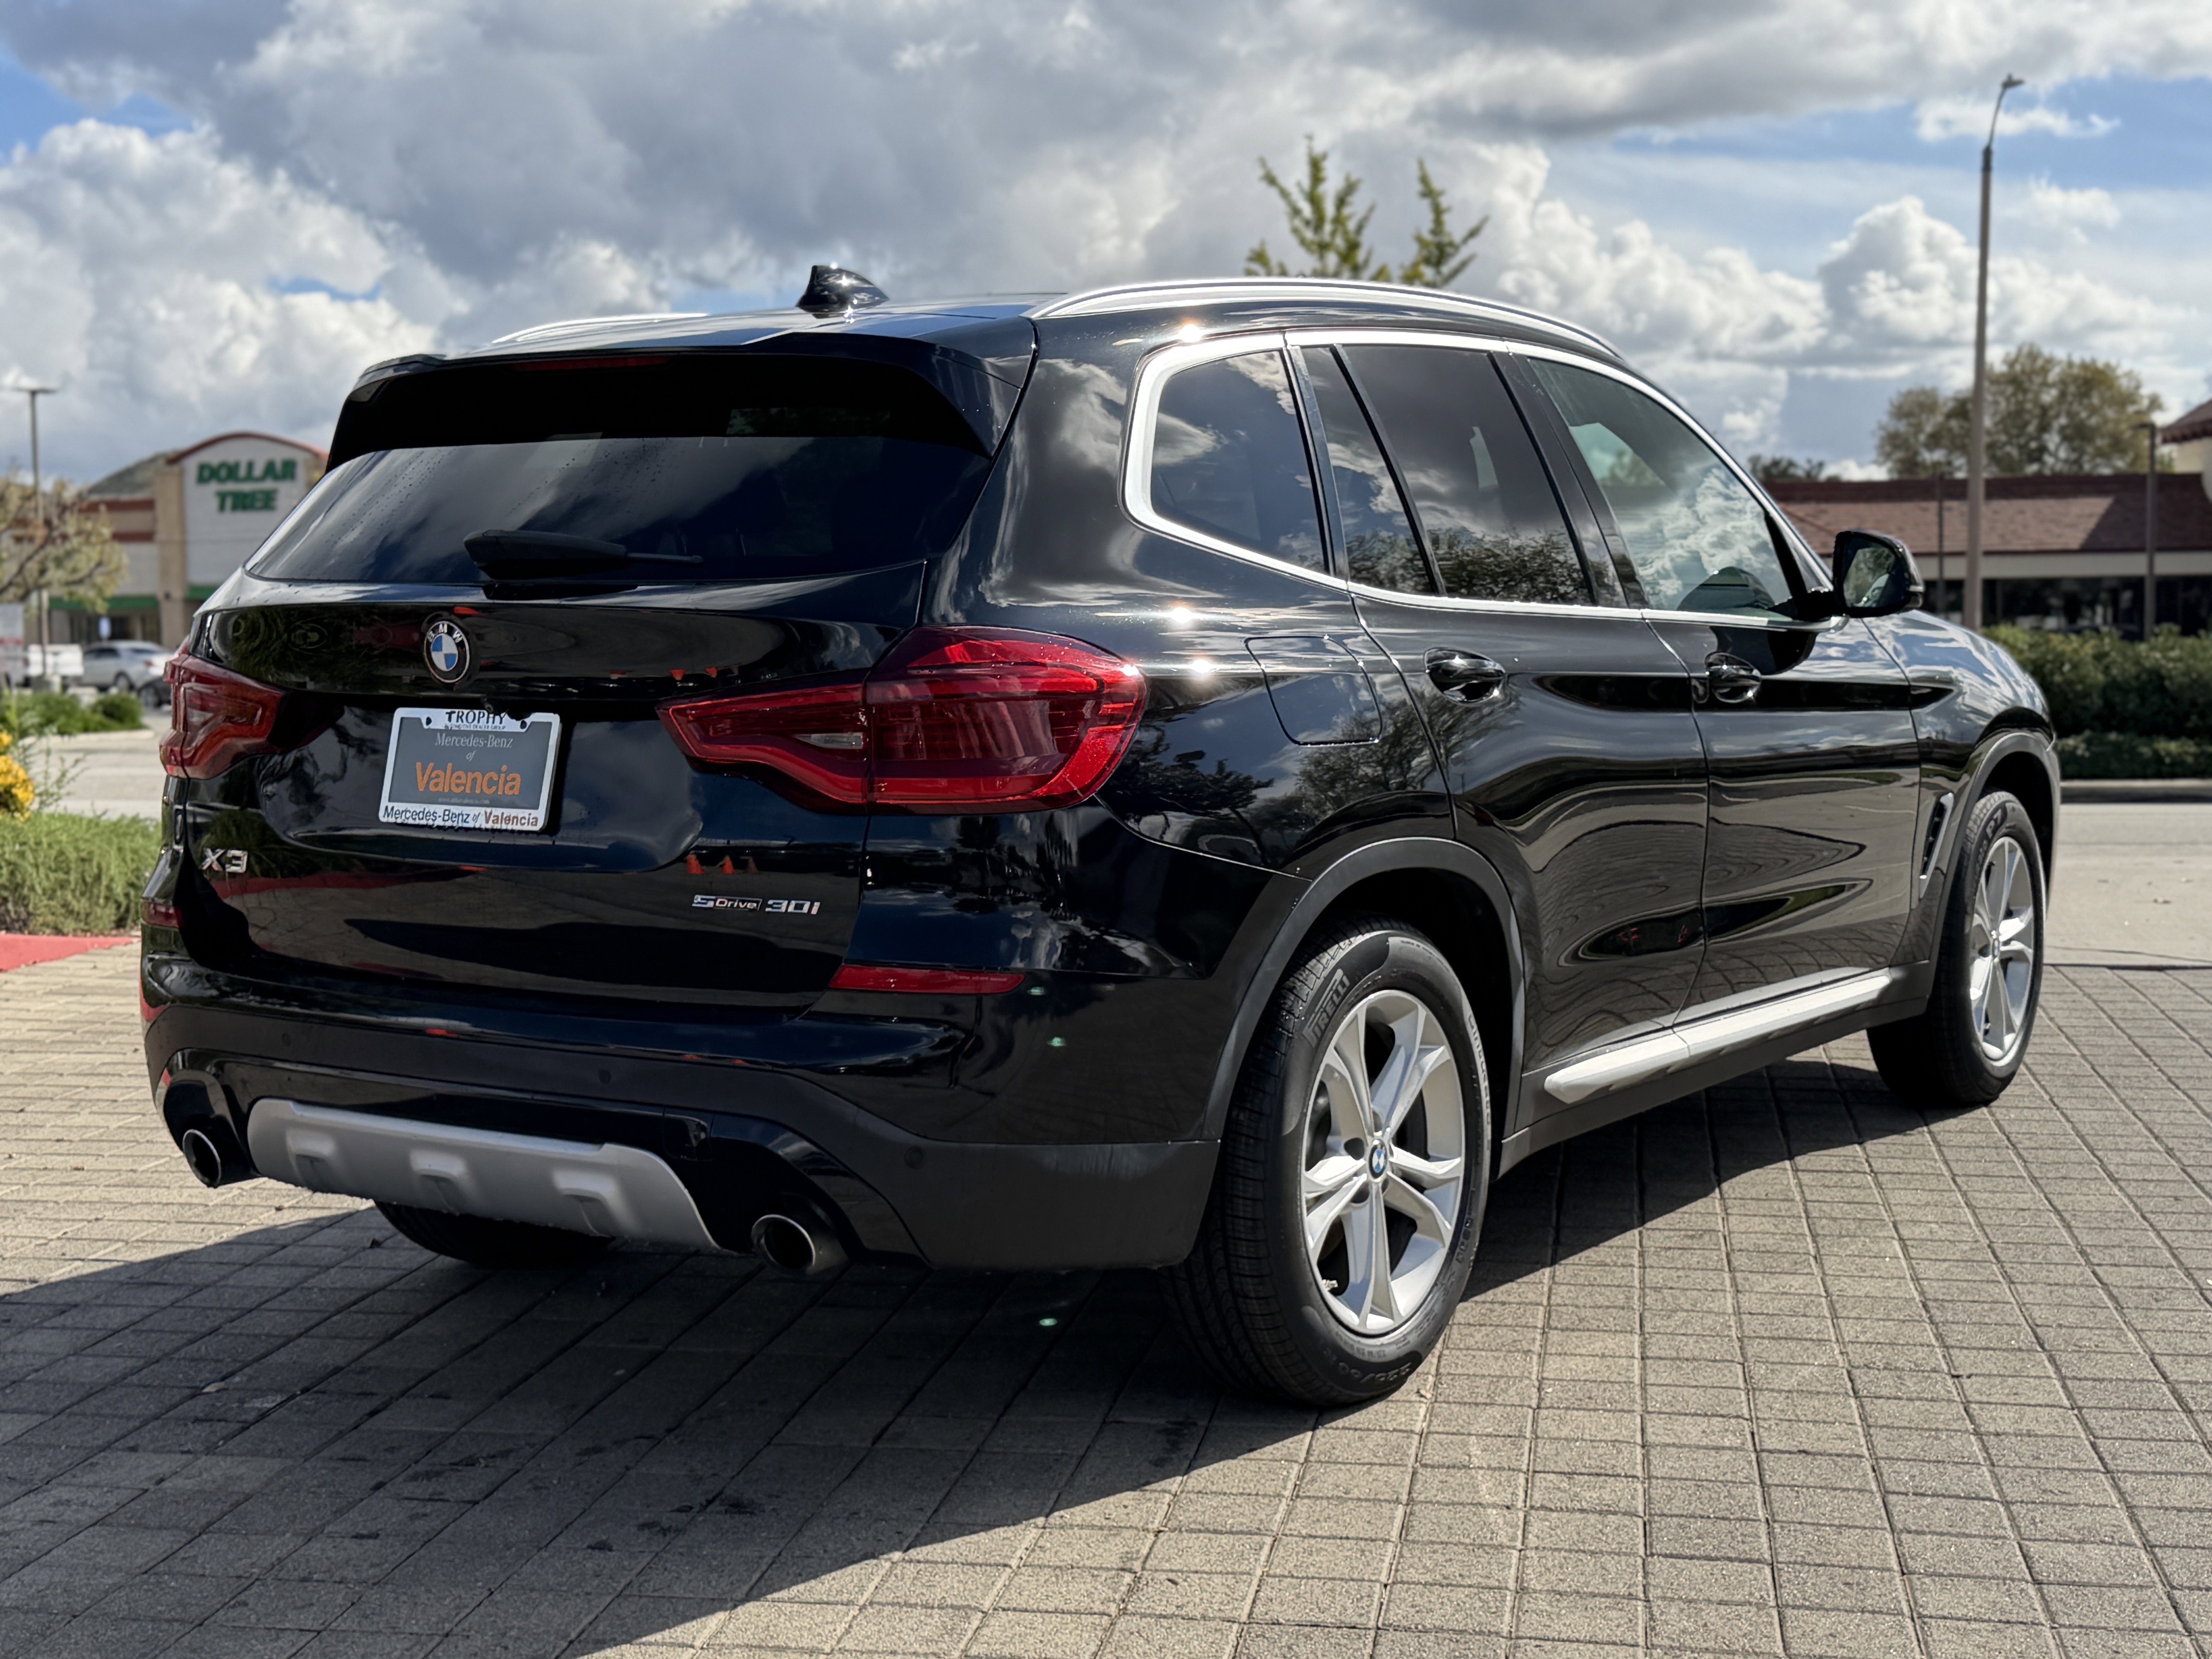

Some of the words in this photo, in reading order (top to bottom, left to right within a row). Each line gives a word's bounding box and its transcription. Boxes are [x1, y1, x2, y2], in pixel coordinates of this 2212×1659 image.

[197, 459, 296, 483] DOLLAR
[215, 489, 277, 512] TREE
[427, 623, 463, 643] BMW
[445, 710, 507, 725] TROPHY
[434, 732, 513, 748] Mercedes-Benz
[466, 750, 476, 761] of
[416, 762, 520, 795] Valencia
[383, 805, 470, 824] Mercedes-Benz
[472, 812, 480, 823] of
[484, 809, 538, 827] Valencia
[199, 847, 248, 873] X3
[1302, 969, 1350, 1048] PIRELLI
